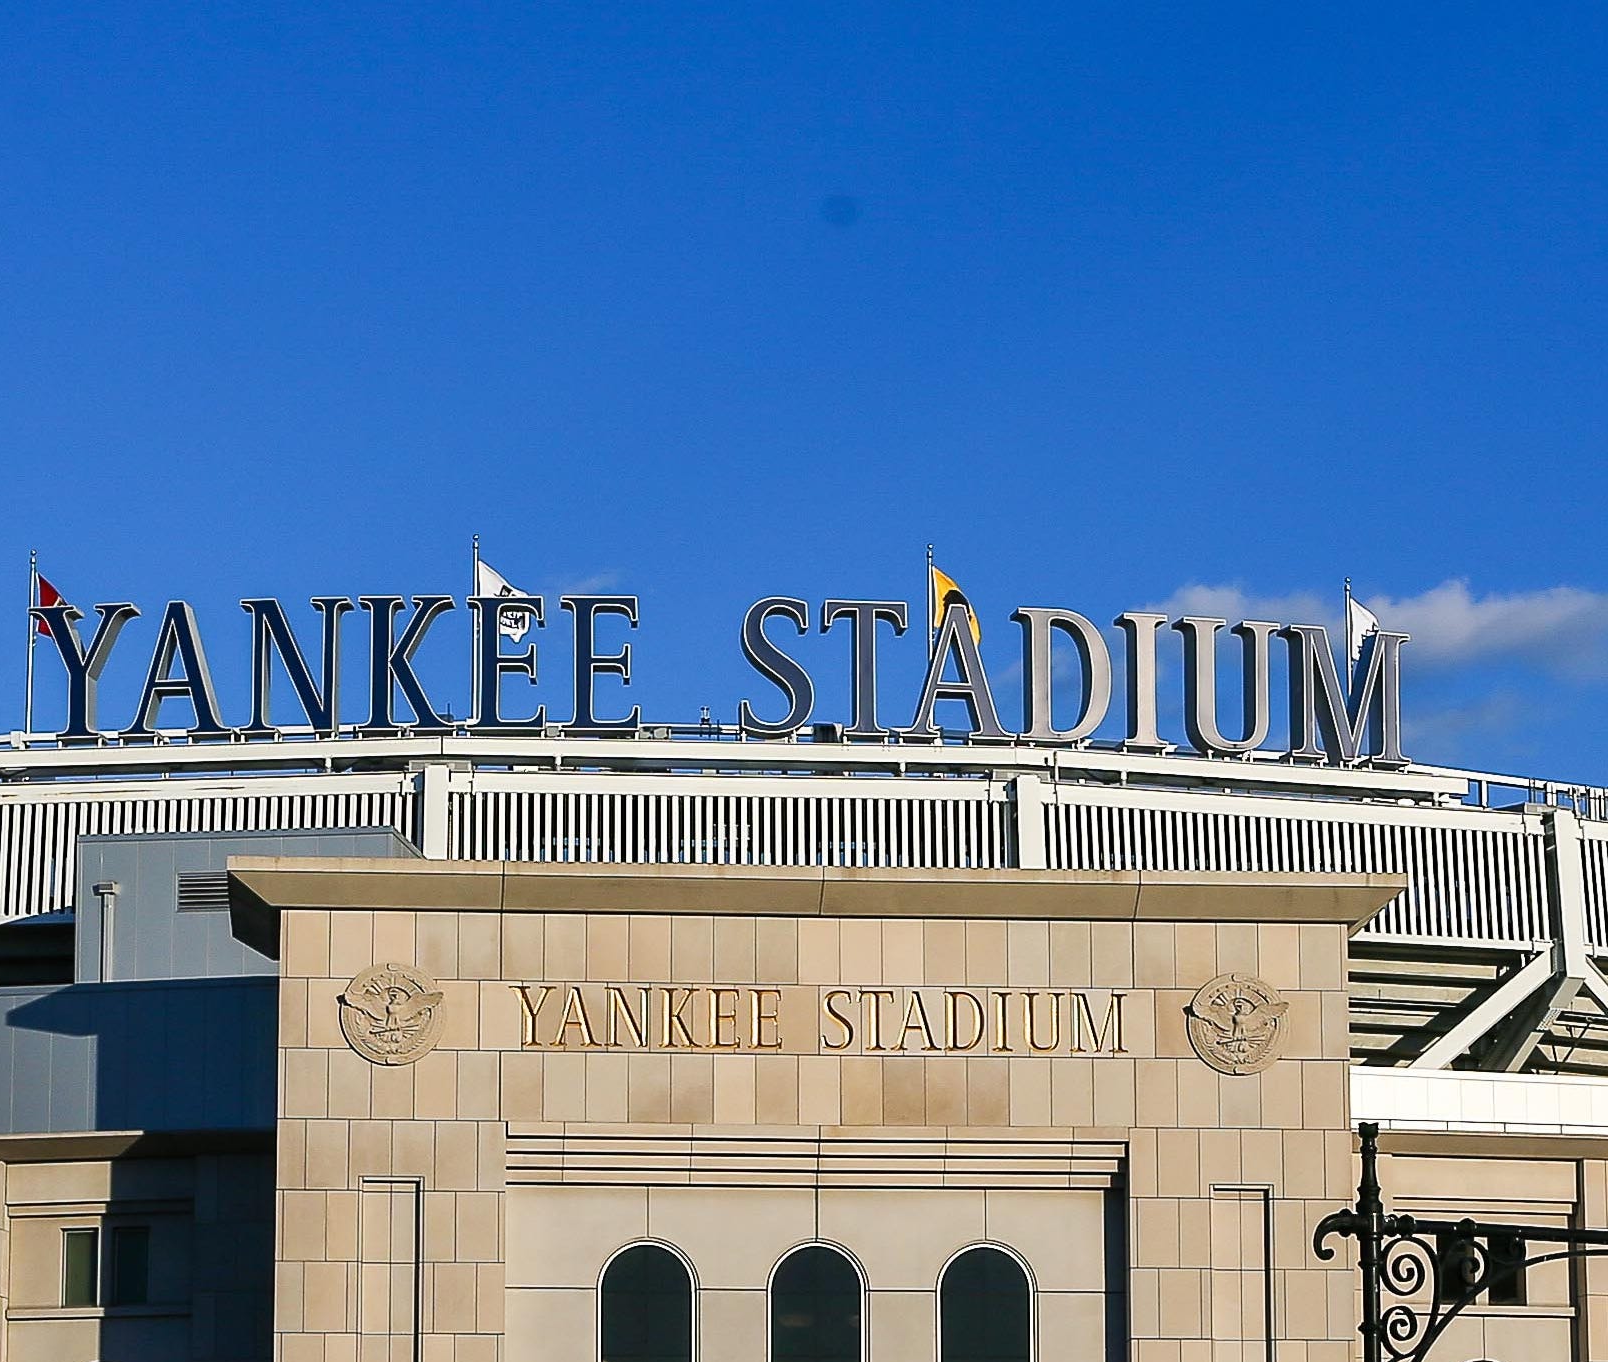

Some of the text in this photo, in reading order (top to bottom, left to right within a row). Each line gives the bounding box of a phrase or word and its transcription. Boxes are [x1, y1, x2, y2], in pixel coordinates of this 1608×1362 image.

[29, 595, 1412, 766] YANKEE STADIUM
[509, 985, 1130, 1055] YANKEE STADIUM
